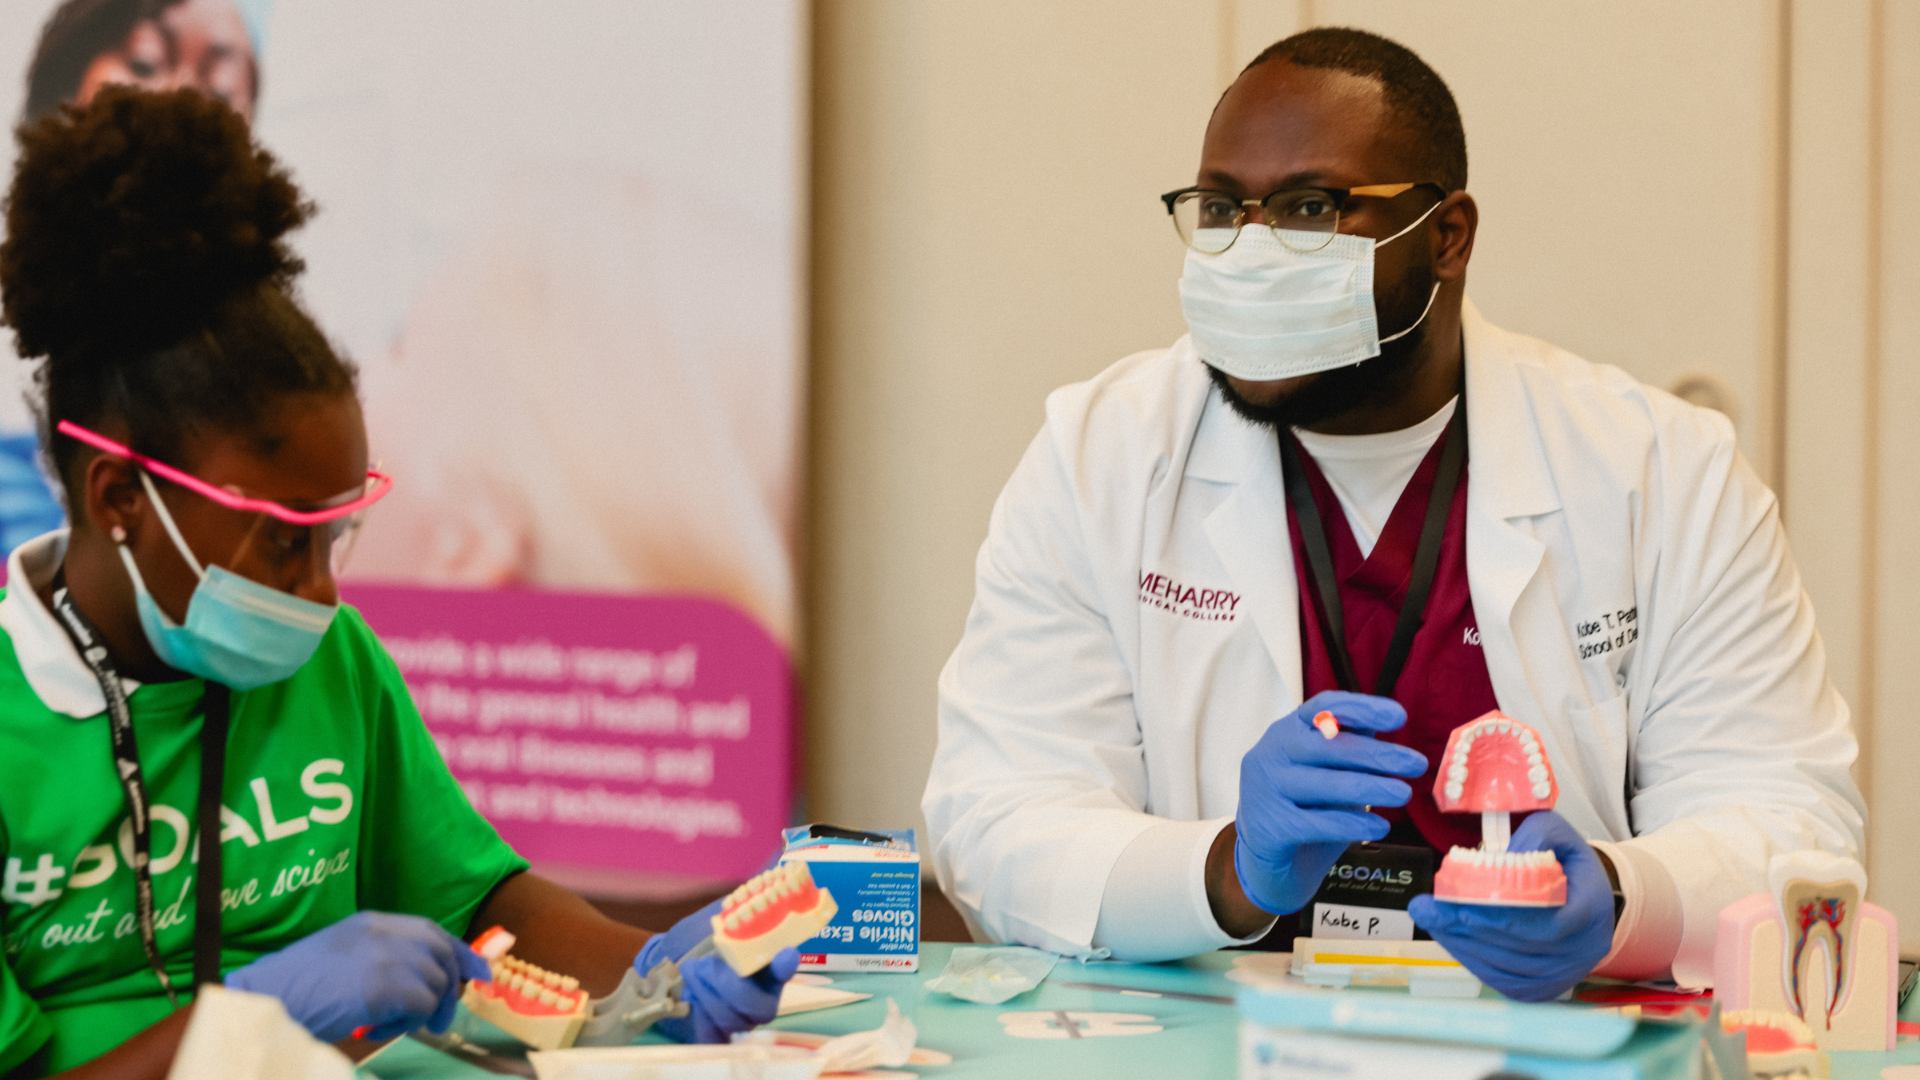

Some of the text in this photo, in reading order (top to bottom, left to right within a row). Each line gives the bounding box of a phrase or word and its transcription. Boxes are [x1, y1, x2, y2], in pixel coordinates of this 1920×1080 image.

[1139, 569, 1241, 611] MEHARRY
[1183, 609, 1236, 621] COLLEGE
[1463, 627, 1482, 646] Ko
[1579, 636, 1613, 660] School
[1616, 631, 1625, 648] of
[41, 899, 114, 949] out
[220, 878, 262, 912] ove
[852, 909, 915, 926] Gloves
[1320, 910, 1360, 930] Kobe
[859, 926, 915, 943] Nitrile
